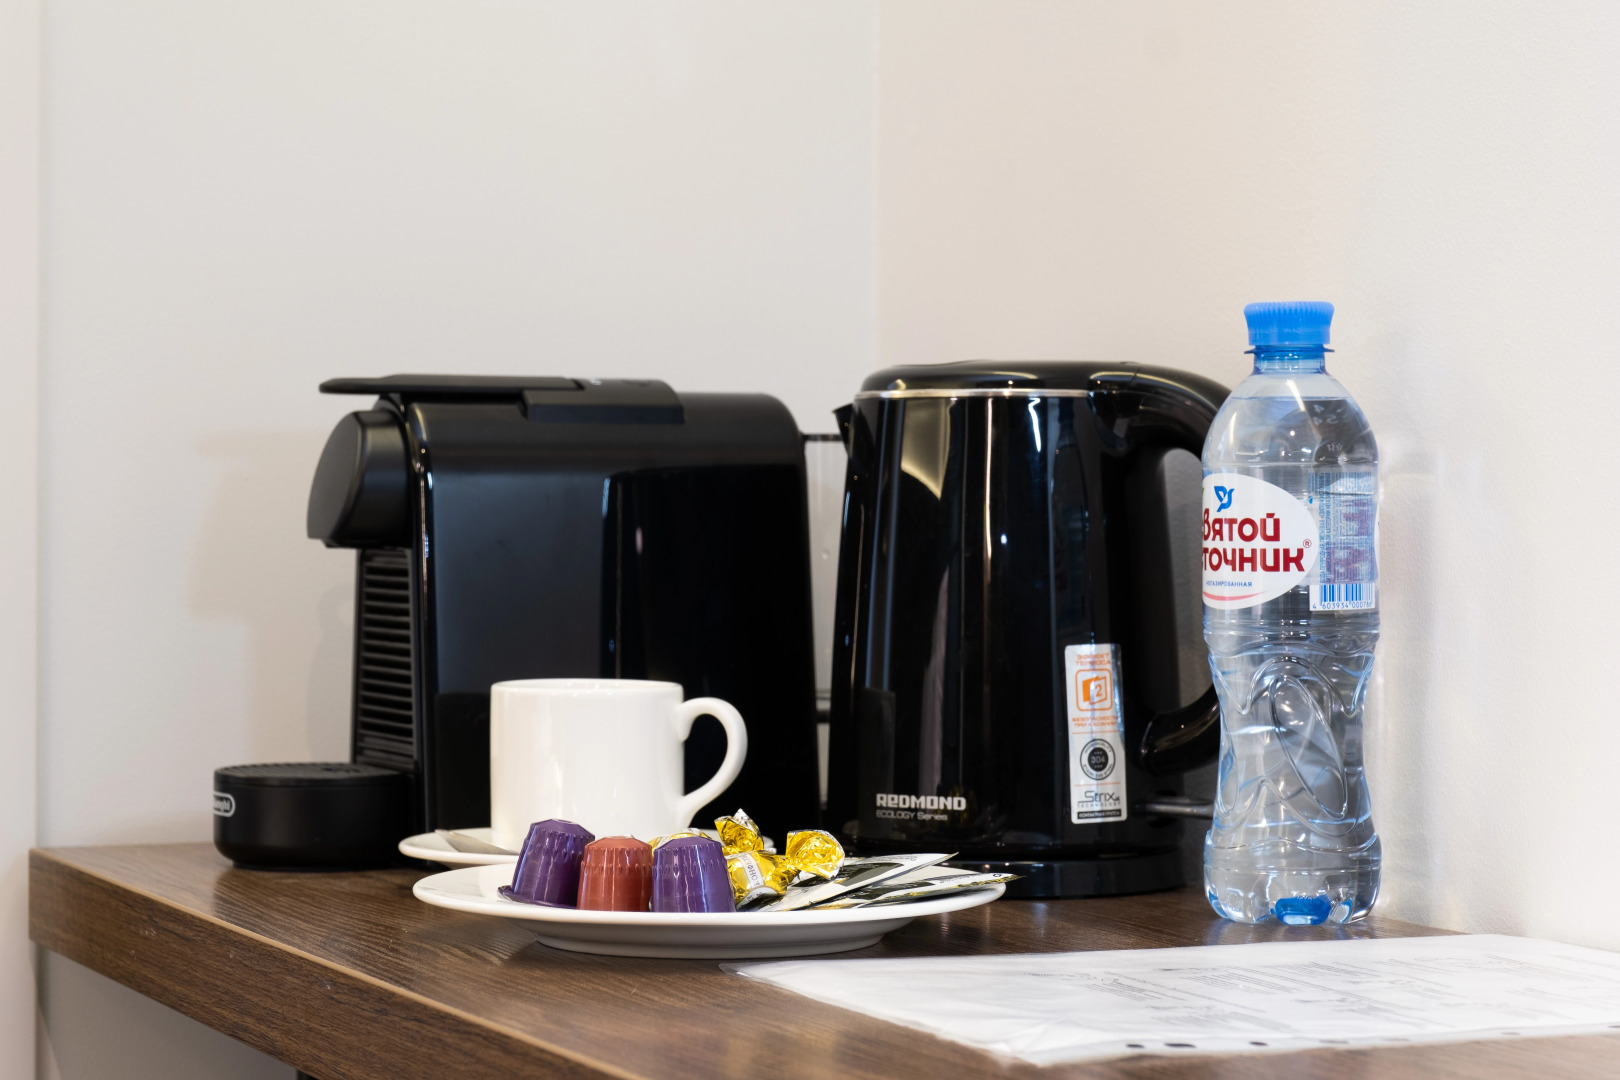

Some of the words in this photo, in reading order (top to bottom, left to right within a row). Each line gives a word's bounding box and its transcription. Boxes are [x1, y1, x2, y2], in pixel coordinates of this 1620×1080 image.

[1202, 508, 1281, 542] ВЯТОЙ
[1202, 547, 1305, 572] ТОЧНИК
[1205, 580, 1253, 588] НЕГАЗИРОВАННАЯ
[1322, 602, 1349, 610] 603934
[1095, 684, 1102, 697] 2
[876, 809, 915, 819] ECOLOGY
[917, 811, 948, 821] Series
